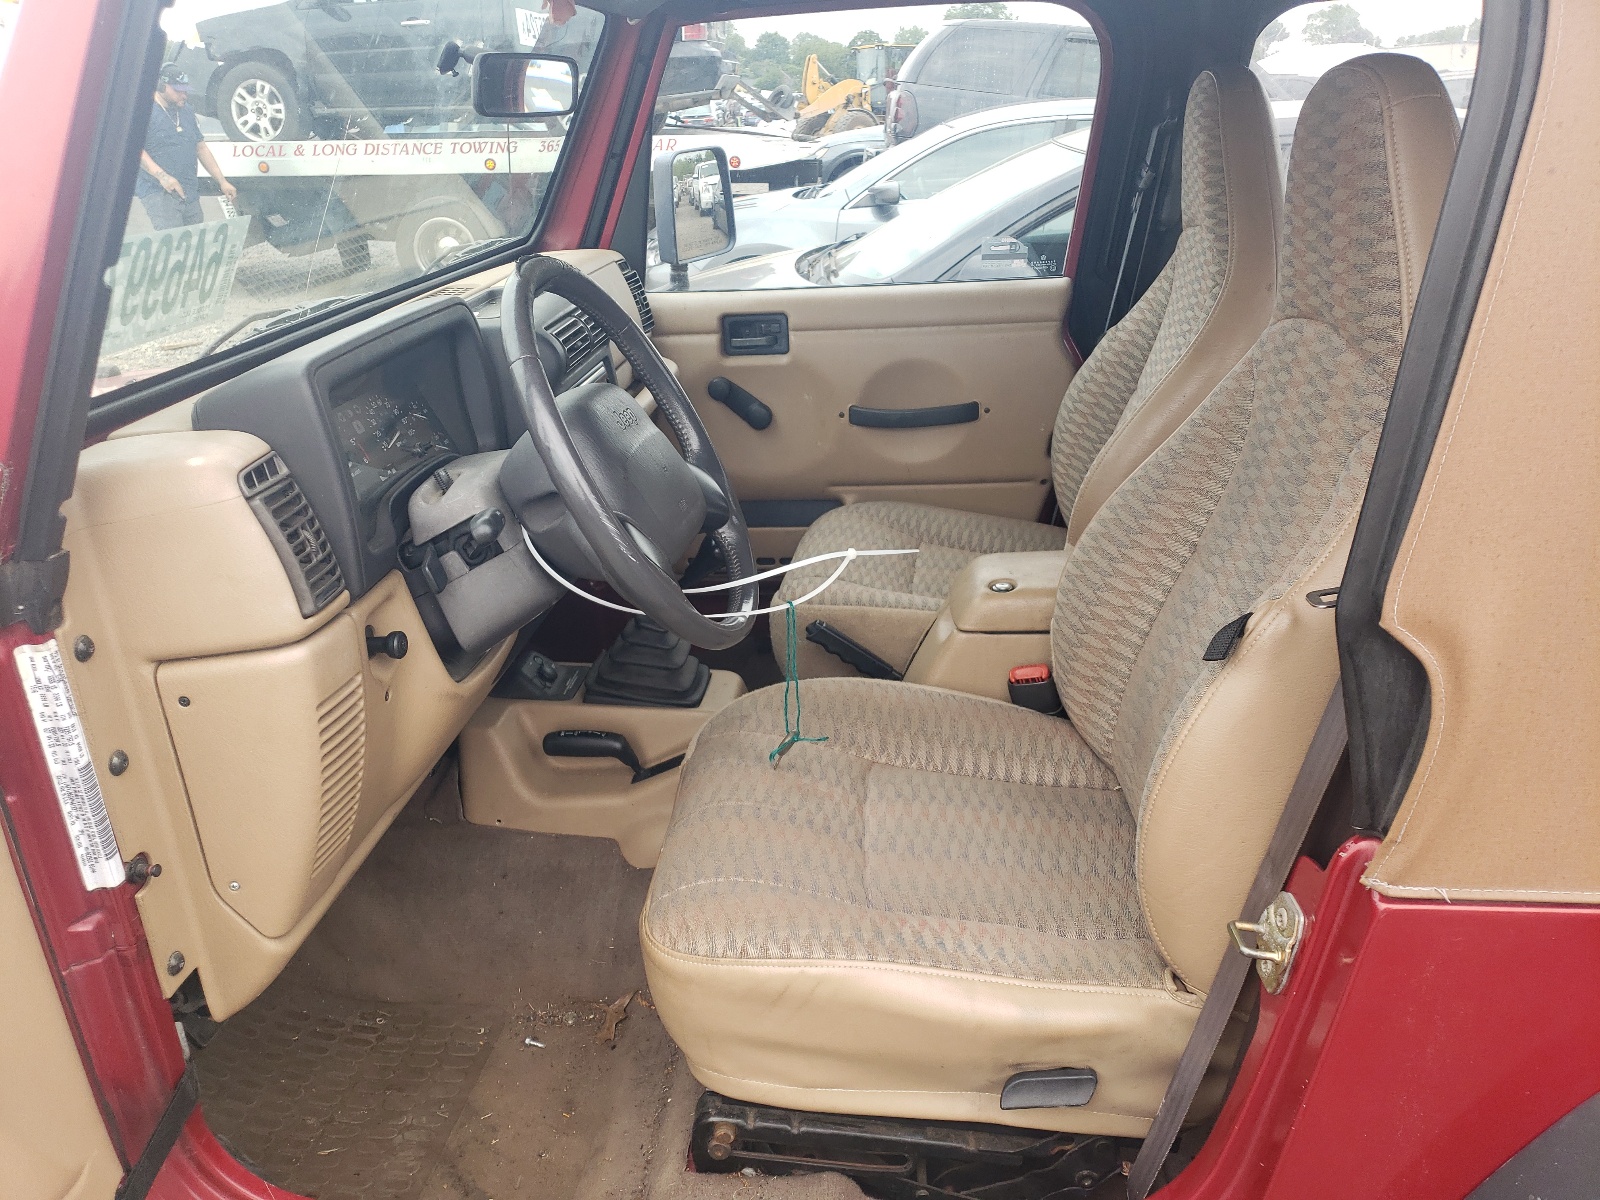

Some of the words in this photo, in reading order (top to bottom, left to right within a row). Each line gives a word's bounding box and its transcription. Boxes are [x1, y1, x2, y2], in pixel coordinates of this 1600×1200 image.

[232, 144, 287, 158] LOCAL
[293, 144, 305, 156] &
[312, 143, 357, 156] LONG
[364, 142, 443, 156] DISTANCE
[450, 140, 519, 155] TOWING
[612, 407, 639, 431] Jeep
